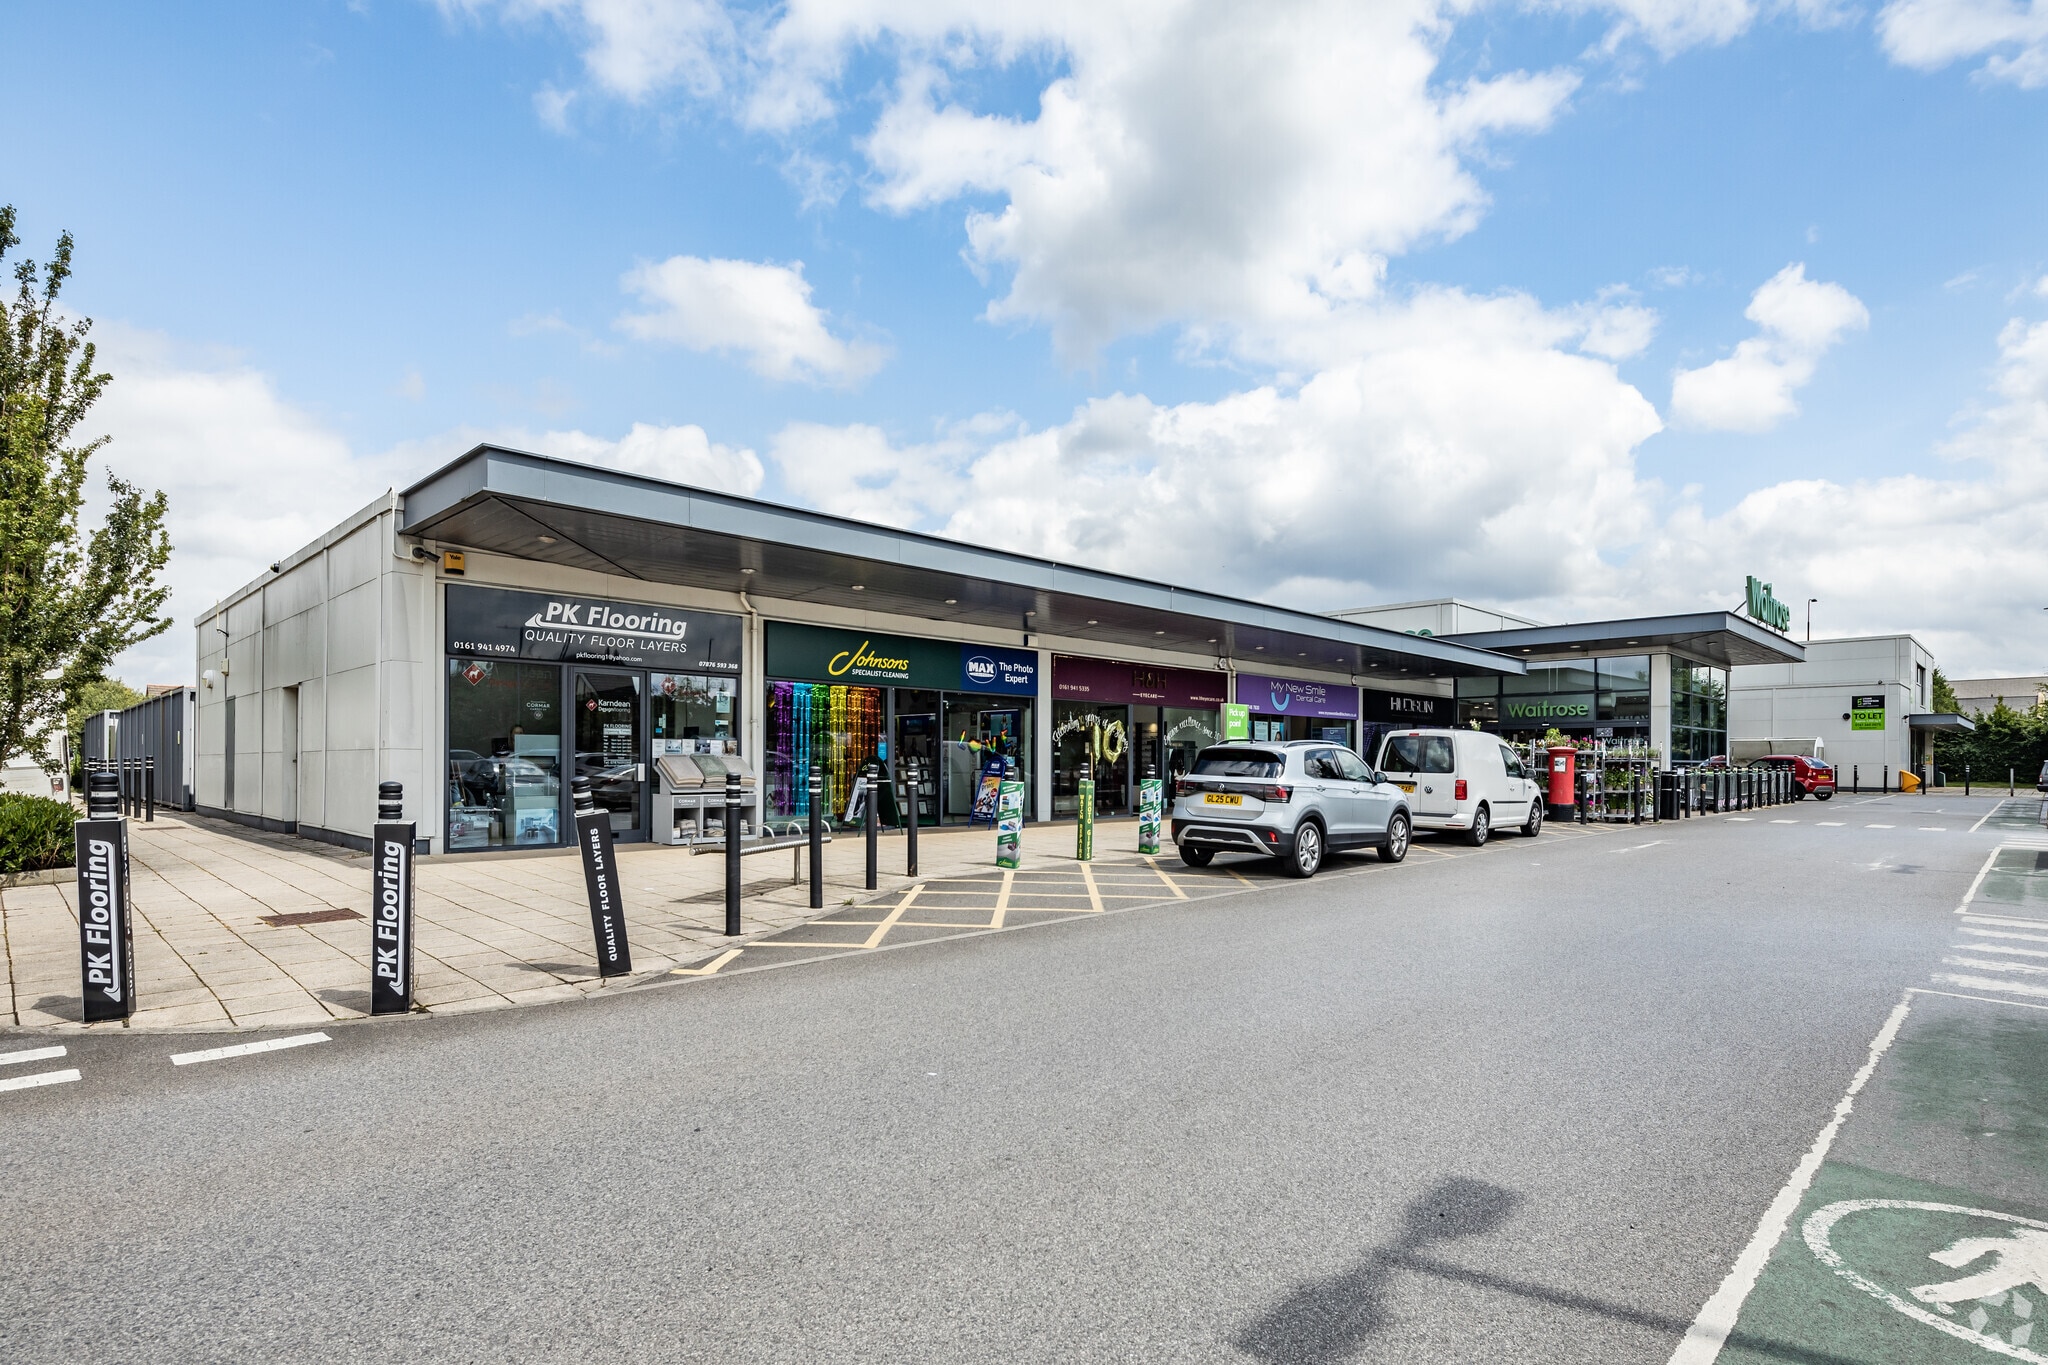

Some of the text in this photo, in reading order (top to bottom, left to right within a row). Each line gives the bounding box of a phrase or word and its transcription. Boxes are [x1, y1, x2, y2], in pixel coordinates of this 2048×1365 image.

[1746, 575, 1790, 632] Waitrose
[545, 602, 687, 636] PK Flooring
[453, 641, 516, 653] 0161 941 4974
[525, 629, 687, 653] QUALITY FLOOR LAYERS
[576, 652, 643, 663] pkflooring1@yahoo.com
[828, 640, 909, 676] Johnsons
[852, 668, 909, 680] SPECIALIST CLEANING
[968, 661, 995, 674] MAX
[999, 661, 1034, 674] The Photo
[1005, 673, 1028, 684] Expert
[1133, 670, 1167, 689] H&H
[1270, 681, 1326, 696] My New Smile
[598, 699, 631, 707] Karndean
[1296, 694, 1326, 704] Dental Care
[1228, 708, 1246, 719] Pick up
[1507, 700, 1589, 719] Waitrose
[1867, 712, 1884, 720] LET
[1228, 718, 1242, 729] point
[1206, 795, 1240, 805] GL25 CWU
[590, 827, 618, 962] QUALITY FLOOR LAYERS
[83, 839, 114, 984] PK Flooring
[376, 840, 404, 979] PK Flooring
